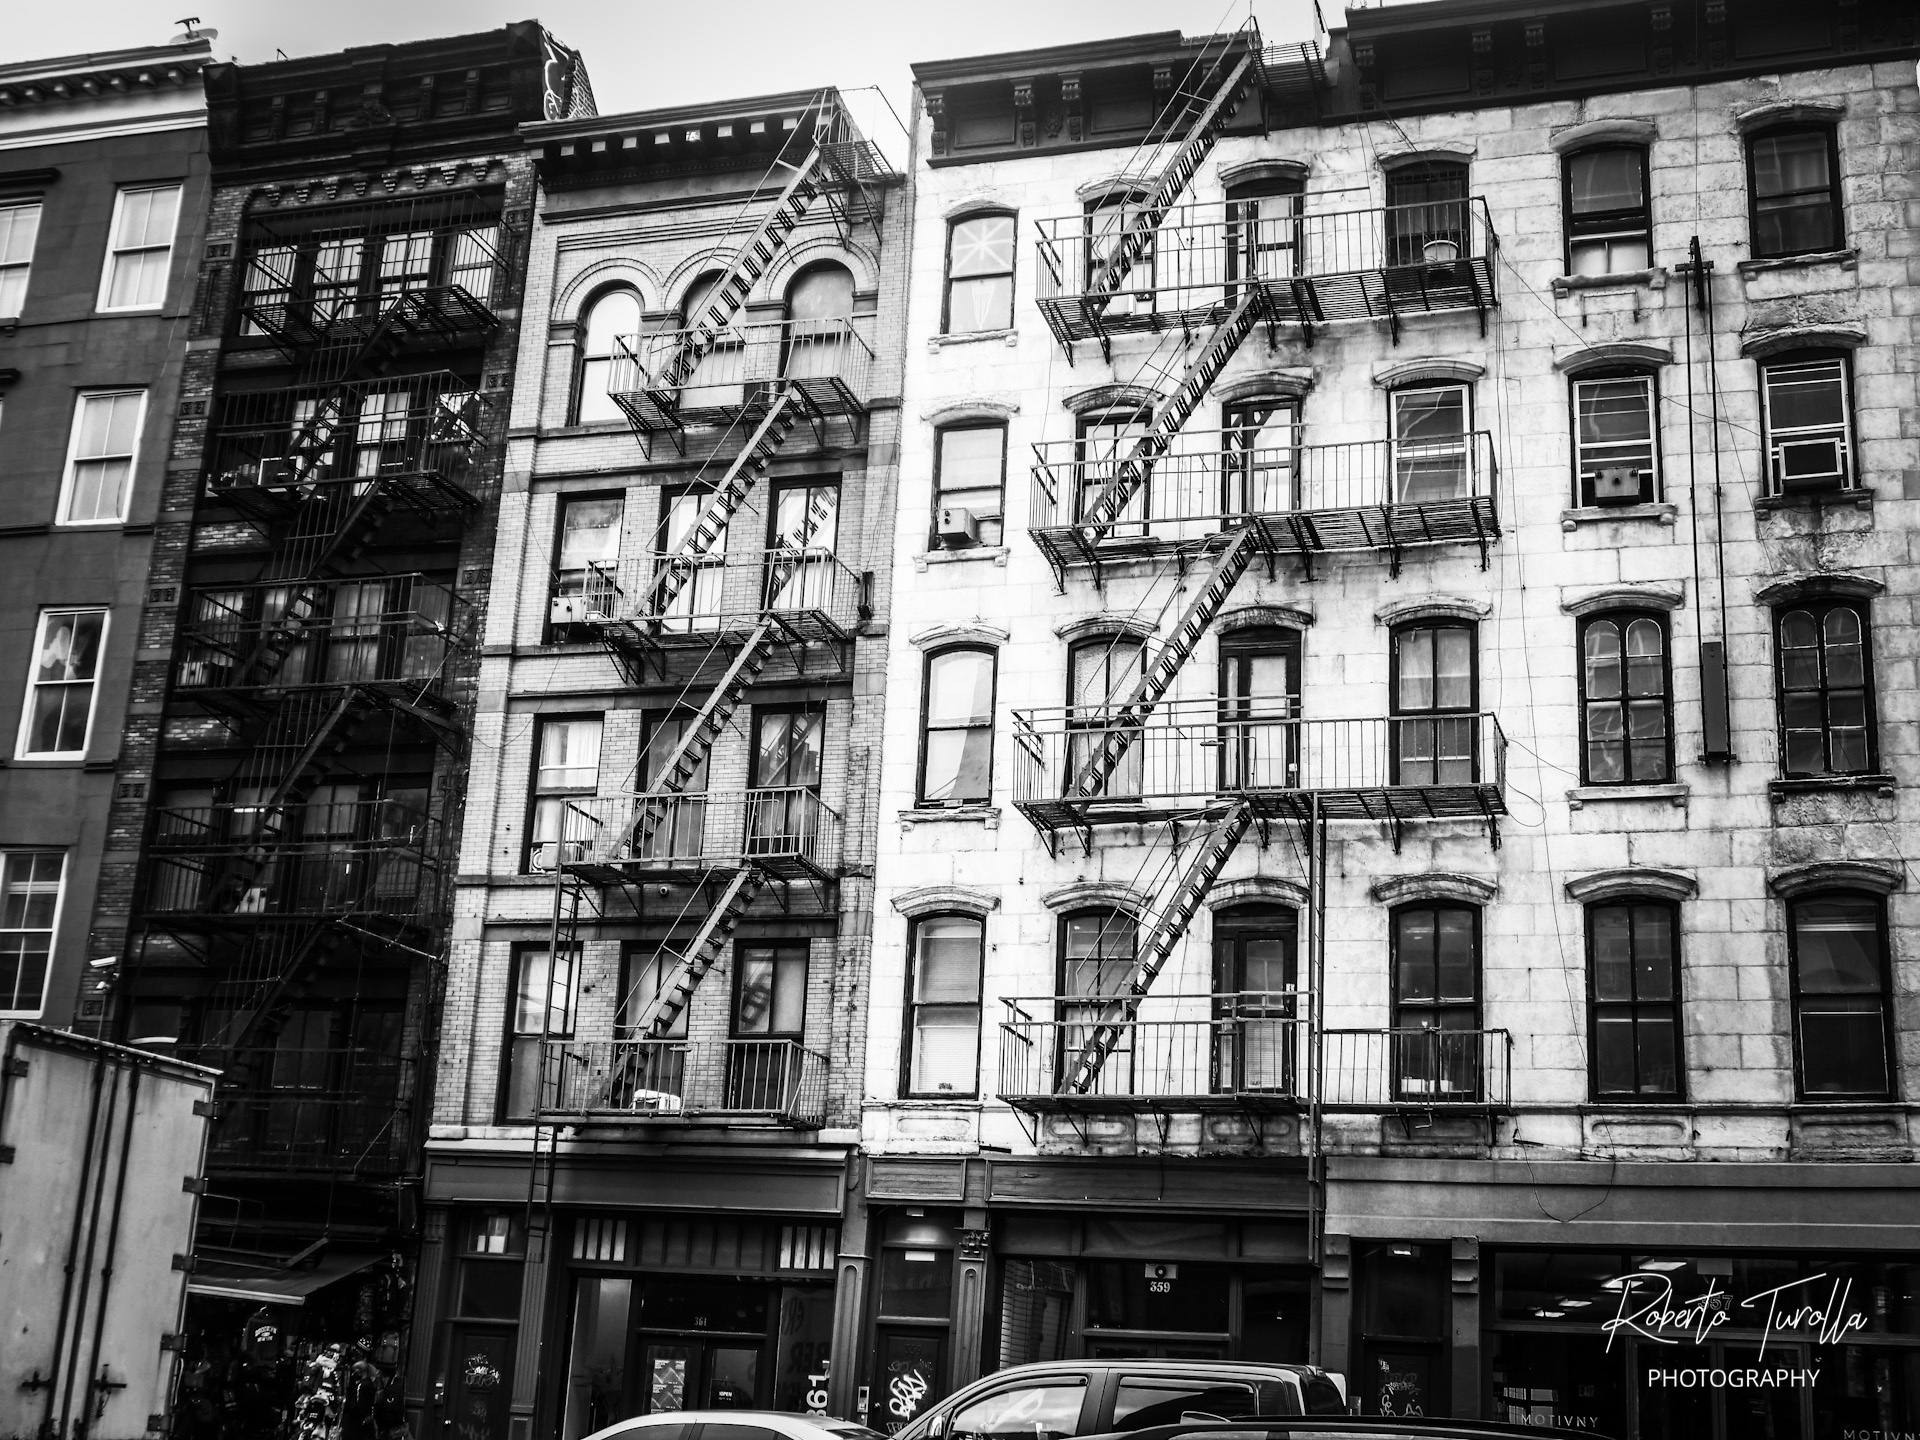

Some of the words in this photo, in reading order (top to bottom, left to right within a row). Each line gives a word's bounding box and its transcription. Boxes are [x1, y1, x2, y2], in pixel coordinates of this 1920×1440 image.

[1149, 1281, 1171, 1293] 359
[1698, 1294, 1733, 1310] 357
[694, 1316, 707, 1327] 361
[1577, 1384, 1595, 1397] EXIT
[1521, 1414, 1598, 1428] MOTIVNY
[1843, 1429, 1920, 1440] MOTIVN
